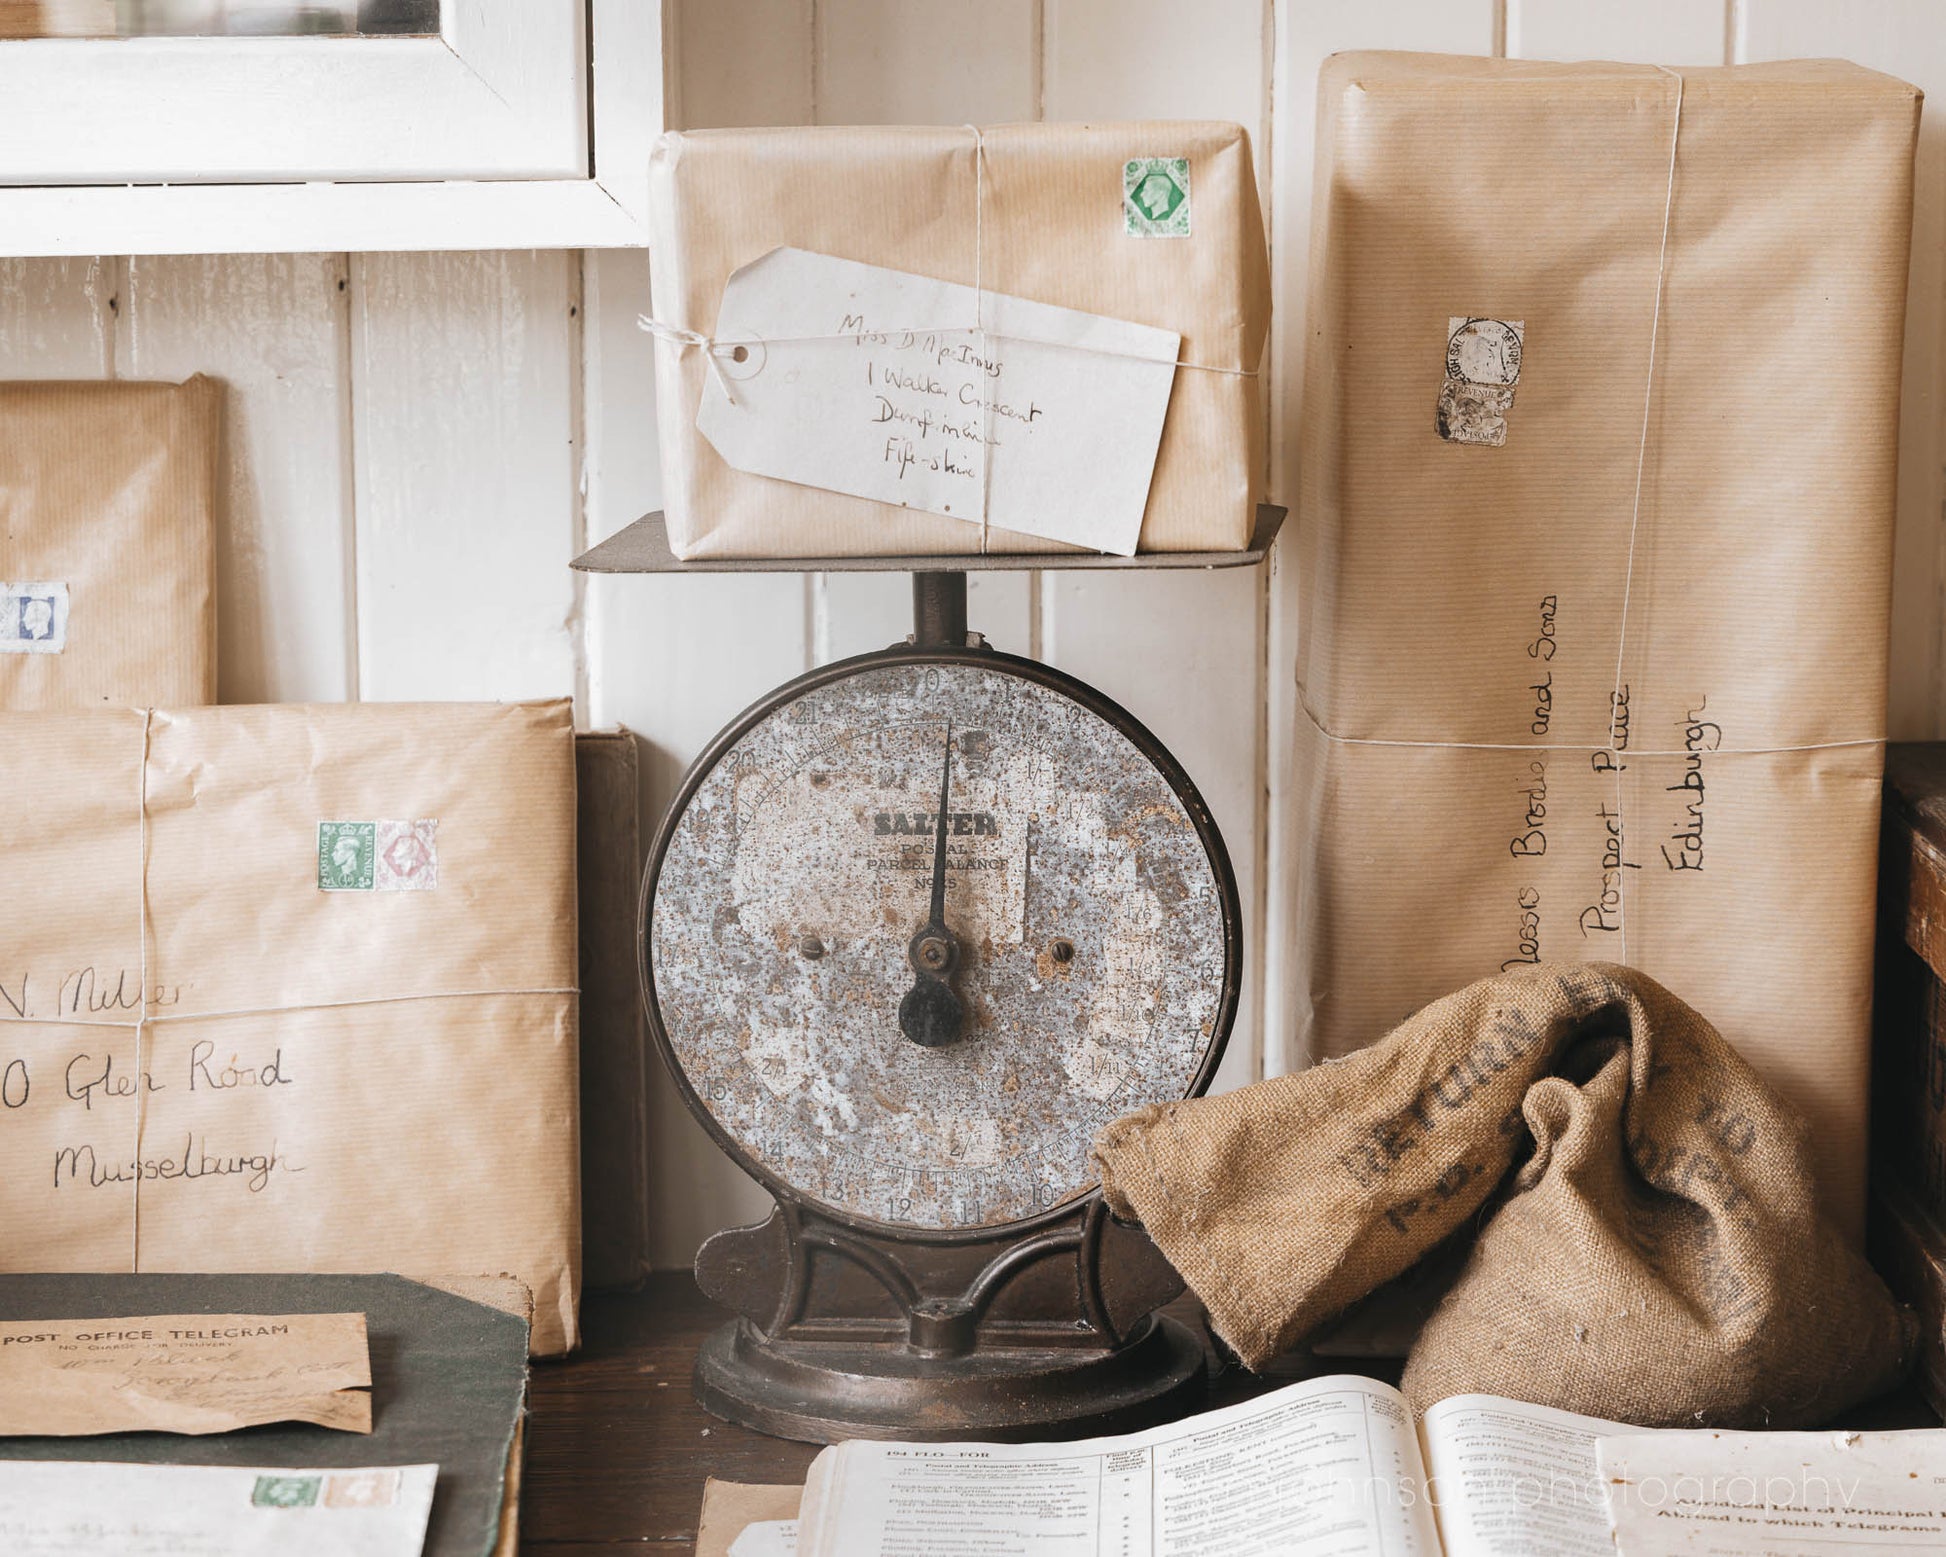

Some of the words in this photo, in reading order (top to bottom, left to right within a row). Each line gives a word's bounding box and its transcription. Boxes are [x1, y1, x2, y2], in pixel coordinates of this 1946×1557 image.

[1527, 594, 1558, 662] Sons
[925, 668, 940, 693] 0
[795, 701, 818, 725] 21
[1530, 671, 1552, 736] and
[1661, 694, 1723, 872] Edinburgh
[874, 813, 998, 836] SALTER
[901, 843, 968, 855] POSAL
[867, 859, 931, 871] PARCEL
[945, 858, 1008, 871] ALANCE
[1579, 802, 1642, 938] Prospect
[1201, 959, 1214, 983] 6
[58, 966, 180, 1017] Miller
[1184, 1028, 1200, 1053] 7
[66, 1054, 166, 1110] Glen
[190, 1040, 292, 1091] Road
[705, 1076, 727, 1101] 15
[55, 1132, 306, 1193] Musselburgh
[760, 1140, 785, 1164] 14
[1030, 1184, 1055, 1208] 10
[888, 1198, 912, 1222] 12
[960, 1200, 983, 1225] 11
[3, 1333, 60, 1346] POST
[76, 1330, 153, 1342] OFFICE
[169, 1324, 288, 1340] TELEGRAM
[1676, 1498, 1766, 1511] Abridged
[1772, 1504, 1810, 1514] List
[1816, 1506, 1836, 1514] of
[1842, 1507, 1934, 1519] Principal
[1657, 1509, 1731, 1522] Abroad
[1738, 1515, 1758, 1524] to
[1764, 1518, 1825, 1528] which
[1831, 1520, 1942, 1533] Telegrams
